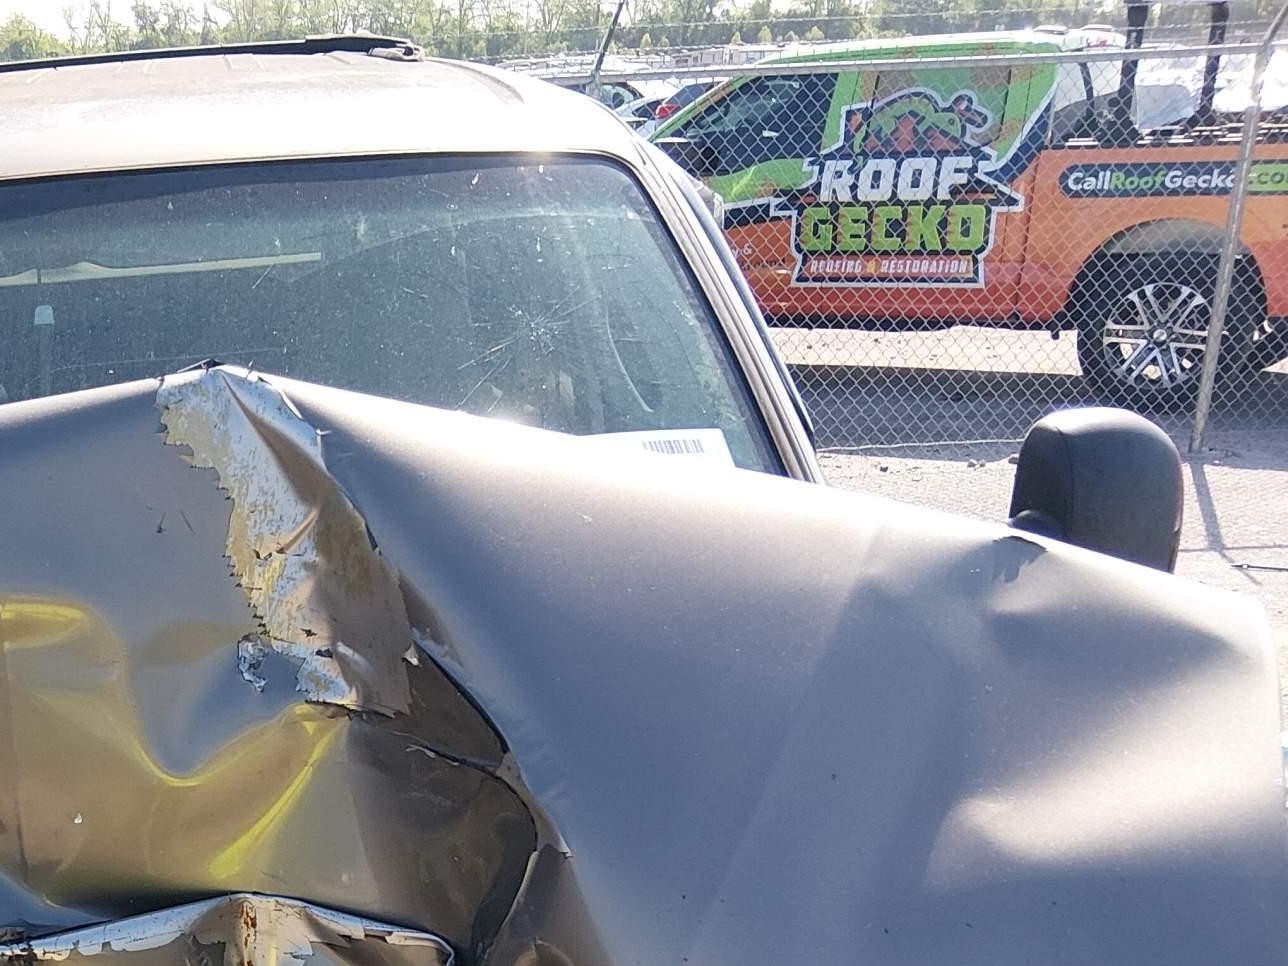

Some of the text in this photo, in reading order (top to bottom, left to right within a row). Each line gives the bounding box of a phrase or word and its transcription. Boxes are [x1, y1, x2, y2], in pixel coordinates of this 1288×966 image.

[819, 156, 974, 201] ROOF
[799, 204, 987, 251] GECKO
[810, 259, 863, 274] ROOFING
[880, 259, 968, 274] RESTORATION
